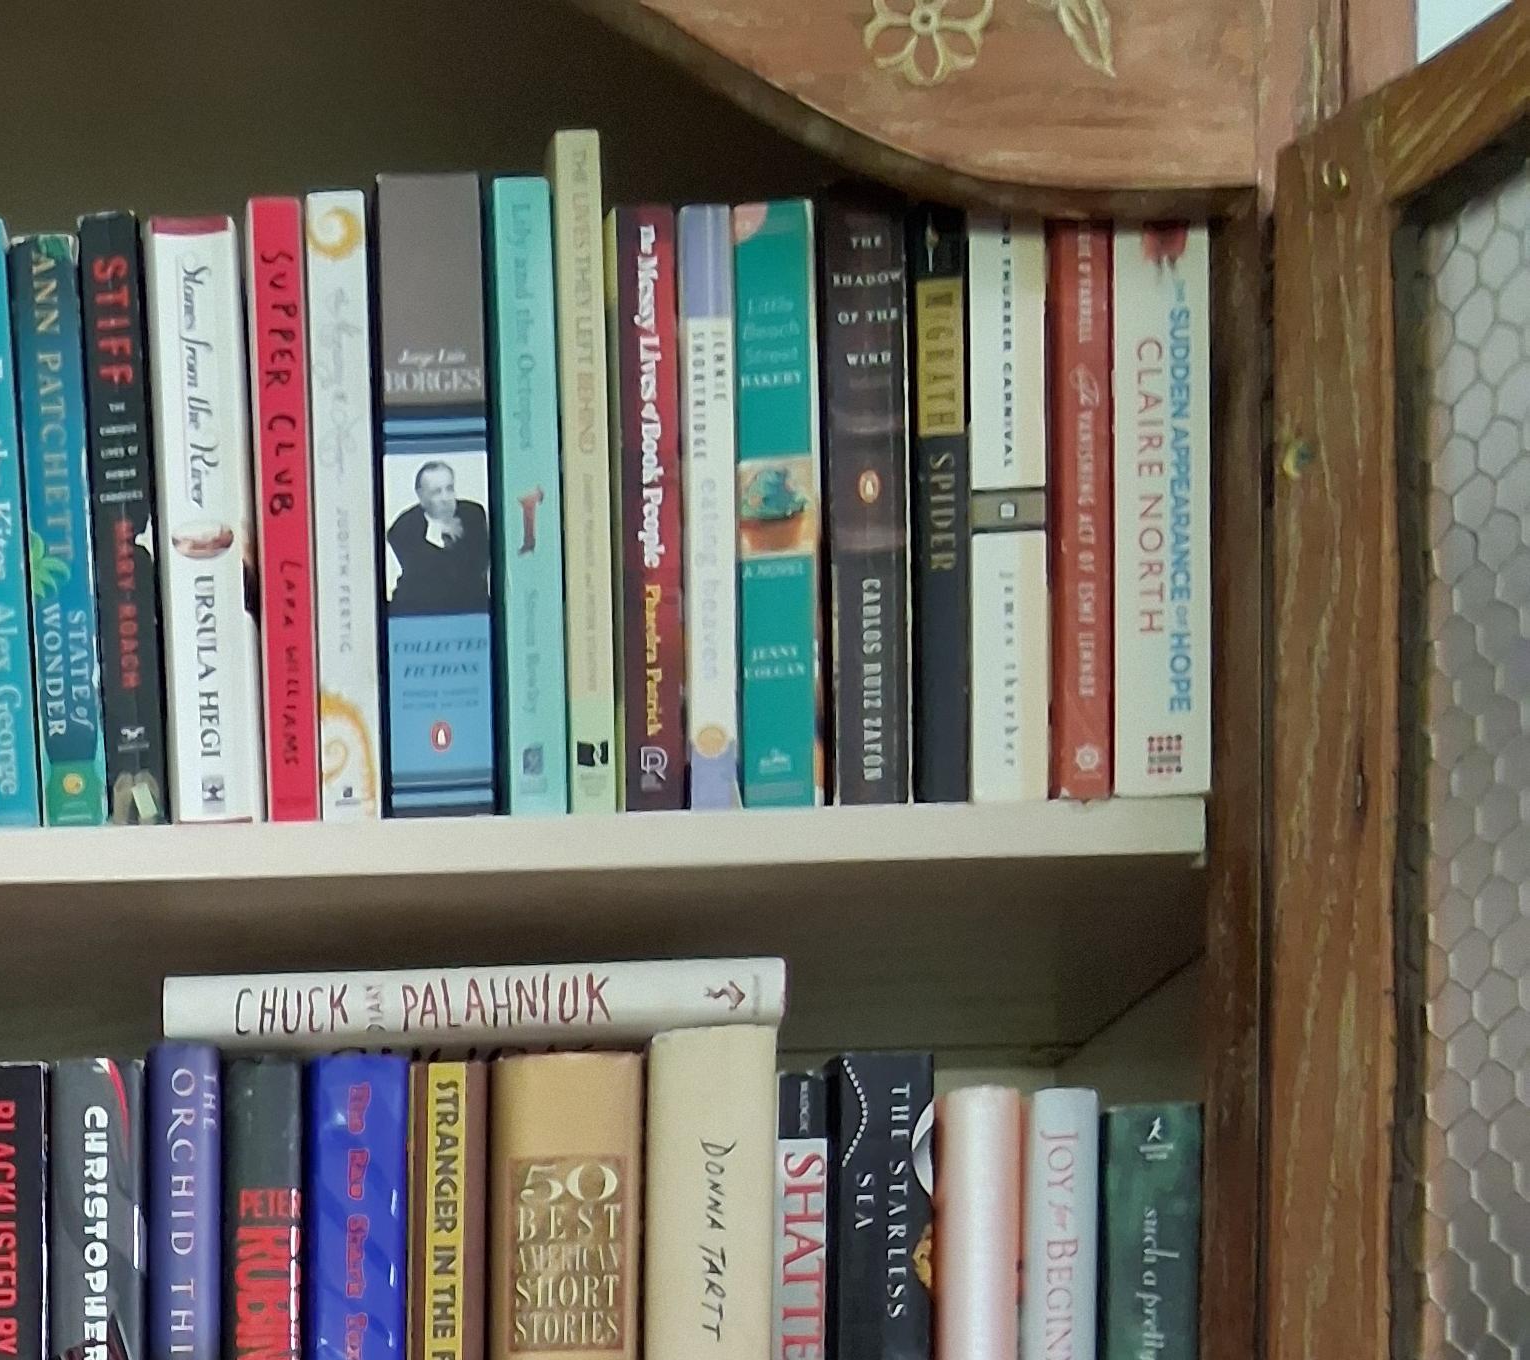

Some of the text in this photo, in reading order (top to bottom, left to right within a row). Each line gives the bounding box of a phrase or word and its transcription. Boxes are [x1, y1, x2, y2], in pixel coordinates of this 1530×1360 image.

[92, 257, 133, 383] STIFF
[270, 415, 294, 516] CLUB
[1136, 337, 1165, 634] CLAIRE NORTH
[193, 574, 221, 757] URSULA HEGI
[234, 972, 614, 1036] CHUCK PALAHNIUK
[434, 1079, 461, 1235] STRANGER
[434, 1246, 458, 1274] IN
[700, 1139, 736, 1341] DONNA TARTT
[432, 1285, 456, 1340] THE
